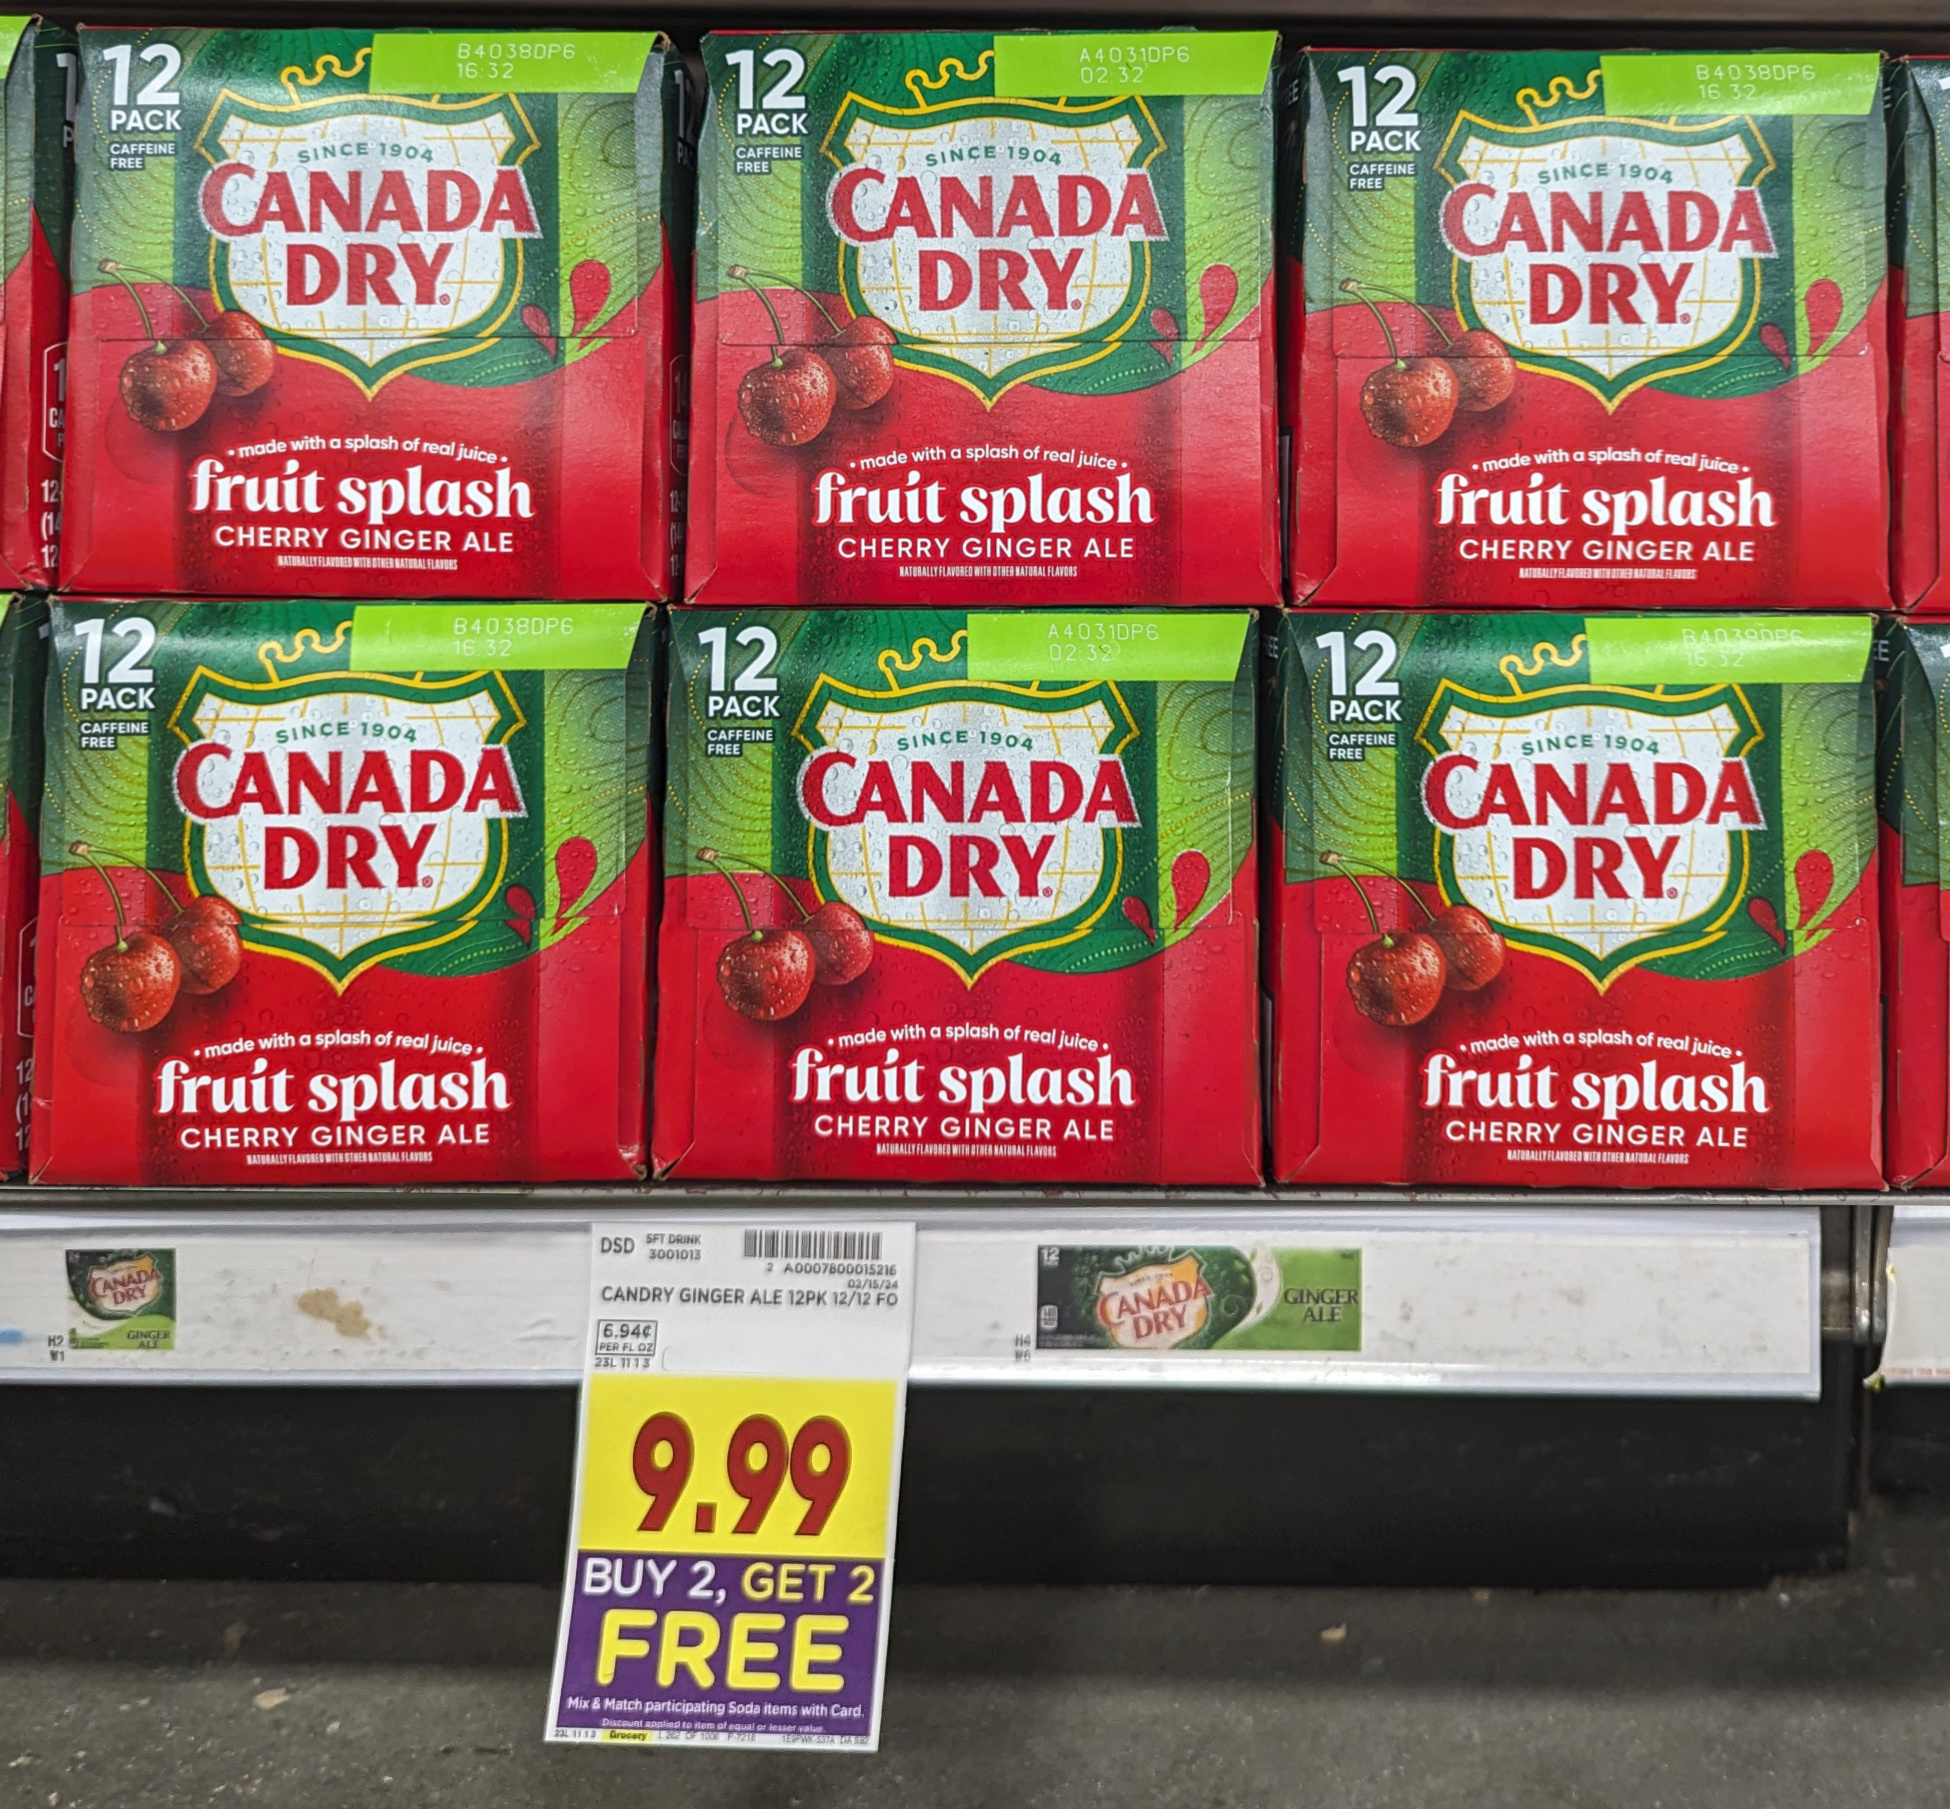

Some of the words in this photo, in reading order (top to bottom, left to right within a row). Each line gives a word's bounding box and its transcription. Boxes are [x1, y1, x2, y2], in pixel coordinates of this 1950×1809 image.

[101, 45, 181, 107] 12
[725, 48, 806, 110] 12
[1338, 66, 1419, 127] 12
[111, 110, 182, 131] PACK
[736, 113, 808, 135] PACK
[110, 143, 175, 154] CAFFEINE
[297, 141, 368, 163] SINCE
[380, 142, 434, 162] 1904
[1349, 130, 1421, 152] PACK
[109, 157, 142, 169] FREE
[736, 147, 802, 158] CAFFEINE
[925, 145, 996, 167] SINCE
[1008, 146, 1062, 166] 1904
[736, 161, 769, 173] FREE
[1350, 164, 1415, 174] CAFFEINE
[1537, 162, 1607, 184] SINCE
[1619, 164, 1672, 183] 1904
[1350, 177, 1382, 189] FREE
[202, 163, 538, 237] CANADA
[831, 167, 1167, 242] CANADA
[1444, 184, 1775, 257] CANADA
[860, 450, 908, 470] made
[911, 446, 946, 462] with
[950, 448, 962, 459] a
[966, 443, 1019, 462] splash
[1022, 445, 1040, 460] of
[1043, 448, 1075, 464] real
[1076, 450, 1117, 470] juice
[193, 458, 326, 513] fruit
[338, 464, 537, 526] splash
[815, 470, 947, 524] fruit
[959, 472, 1157, 533] splash
[1438, 472, 1569, 526] fruit
[1581, 475, 1778, 536] splash
[215, 526, 328, 547] CHERRY
[340, 529, 451, 550] GINGER
[462, 532, 513, 552] ALE
[838, 537, 950, 558] CHERRY
[962, 537, 1072, 558] GINGER
[1083, 538, 1134, 558] ALE
[1460, 539, 1571, 560] CHERRY
[1583, 540, 1692, 560] GINGER
[1703, 541, 1754, 561] ALE
[900, 566, 937, 577] NATURALLY
[939, 566, 973, 577] FLAVORED
[974, 566, 991, 577] WITH
[993, 566, 1014, 577] OTHER
[1015, 566, 1046, 577] NATURAL
[1048, 566, 1077, 577] FLAVORS
[71, 621, 154, 685] 12
[697, 628, 778, 692] 12
[1317, 633, 1400, 696] 12
[81, 688, 155, 710] PACK
[708, 695, 780, 717] PACK
[1328, 699, 1402, 722] PACK
[80, 722, 148, 734] CAFFEINE
[275, 720, 349, 743] SINCE
[361, 721, 417, 742] 1904
[707, 729, 773, 741] CAFFEINE
[80, 737, 114, 749] FREE
[707, 744, 740, 756] FREE
[897, 729, 968, 751] SINCE
[980, 730, 1035, 751] 1904
[1329, 734, 1396, 745] CAFFEINE
[1521, 733, 1592, 755] SINCE
[1604, 734, 1659, 754] 1904
[1329, 748, 1362, 760] FREE
[177, 743, 523, 819] CANADA
[802, 752, 1140, 828] CANADA
[1426, 755, 1763, 830] CANADA
[156, 1058, 296, 1113] fruit
[308, 1058, 513, 1120] splash
[792, 1047, 926, 1102] fruit
[938, 1052, 1138, 1114] splash
[1424, 1053, 1558, 1108] fruit
[1571, 1059, 1772, 1121] splash
[181, 1126, 299, 1148] CHERRY
[311, 1124, 425, 1146] GINGER
[437, 1124, 489, 1144] ALE
[815, 1115, 928, 1136] CHERRY
[940, 1117, 1051, 1138] GINGER
[1062, 1120, 1114, 1140] ALE
[1447, 1121, 1561, 1142] CHERRY
[1573, 1124, 1684, 1145] GINGER
[1696, 1127, 1747, 1147] ALE
[600, 1236, 635, 1254] DSD
[668, 1234, 701, 1245] DRINK
[649, 1248, 701, 1260] 3001013
[847, 1279, 898, 1289] 02/15/24
[112, 1285, 147, 1306] DRY
[601, 1285, 675, 1303] CANDRY
[679, 1287, 745, 1304] GINGER
[750, 1289, 783, 1305] ALE
[788, 1289, 827, 1305] 12PK
[832, 1291, 872, 1306] 12/12
[1098, 1275, 1213, 1328] CANADA
[1283, 1287, 1359, 1305] GINGER
[1132, 1304, 1190, 1340] DRY
[1303, 1306, 1343, 1323] ALE
[603, 1323, 652, 1338] 6.94¢
[599, 1342, 620, 1352] PER
[622, 1342, 634, 1352] FL
[637, 1343, 653, 1352] OZ
[632, 1411, 852, 1536] 9.99
[583, 1557, 677, 1597] BUY
[688, 1560, 727, 1605] 2,
[742, 1562, 835, 1602] GET
[847, 1565, 875, 1603] 2
[597, 1608, 850, 1692] FREE
[567, 1696, 590, 1709] Mix
[592, 1697, 600, 1710] &
[604, 1698, 643, 1711] Match
[645, 1699, 725, 1714] participating
[728, 1701, 761, 1714] Soda
[764, 1702, 798, 1716] items
[801, 1703, 828, 1717] with
